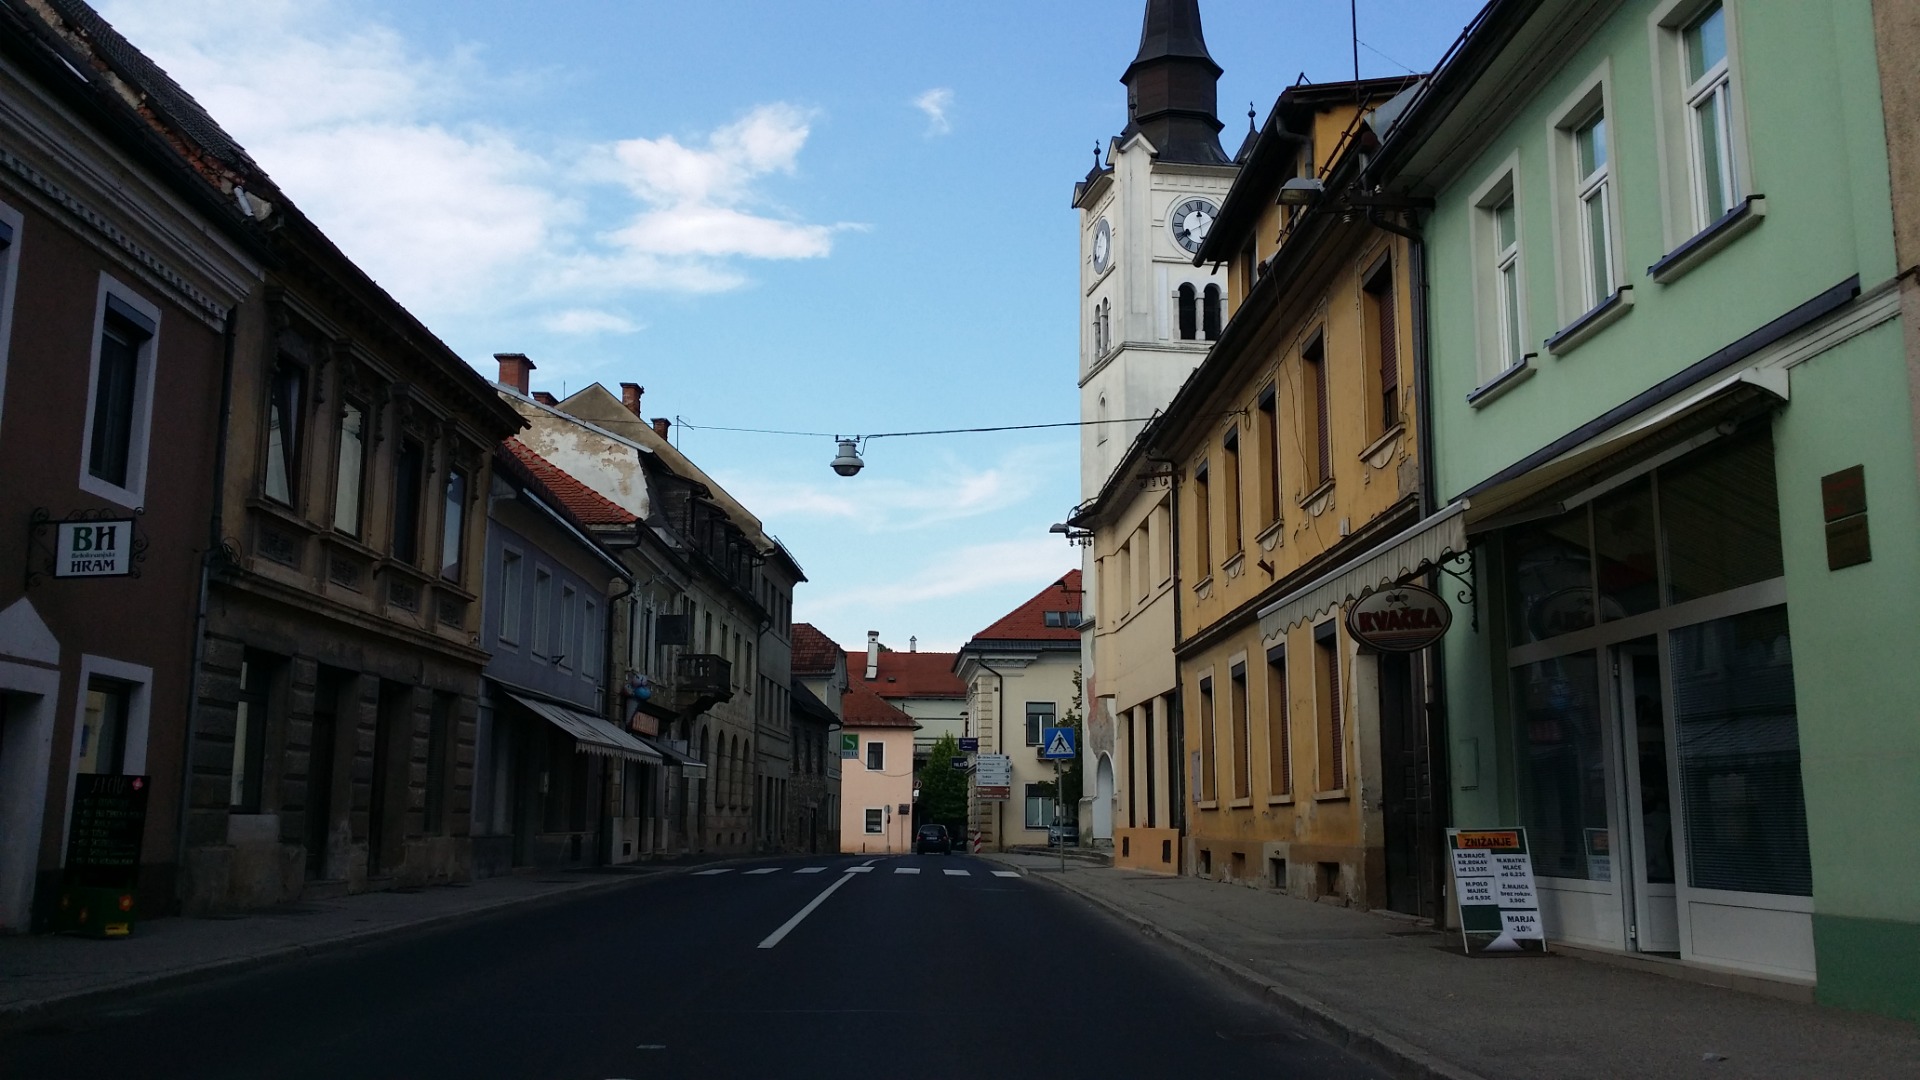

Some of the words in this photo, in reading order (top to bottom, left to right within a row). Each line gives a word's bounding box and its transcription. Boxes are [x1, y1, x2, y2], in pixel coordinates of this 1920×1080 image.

[72, 526, 117, 551] BH
[70, 559, 115, 573] HRAM
[1357, 606, 1443, 633] KVAČKA
[1465, 836, 1511, 846] ZNIŽANJE
[1507, 915, 1536, 923] MARJA
